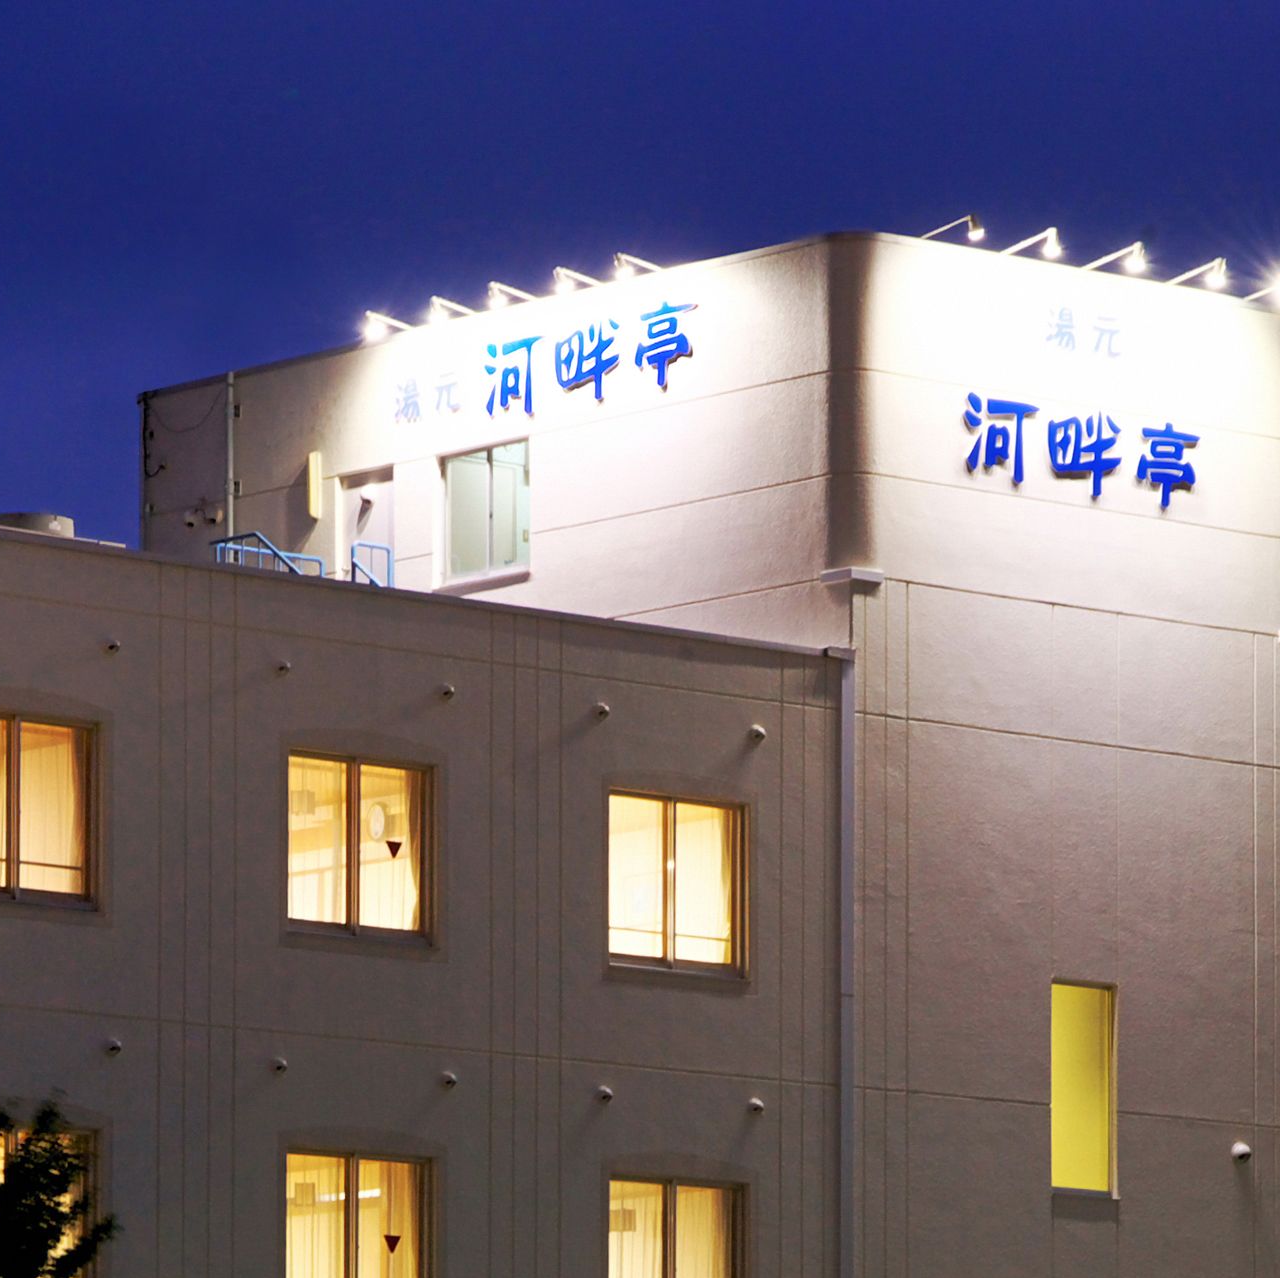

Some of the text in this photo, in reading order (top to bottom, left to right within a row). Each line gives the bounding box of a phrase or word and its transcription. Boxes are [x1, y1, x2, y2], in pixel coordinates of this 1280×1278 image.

[484, 301, 699, 417] 河畔亭
[964, 392, 1201, 509] 河畔亭
